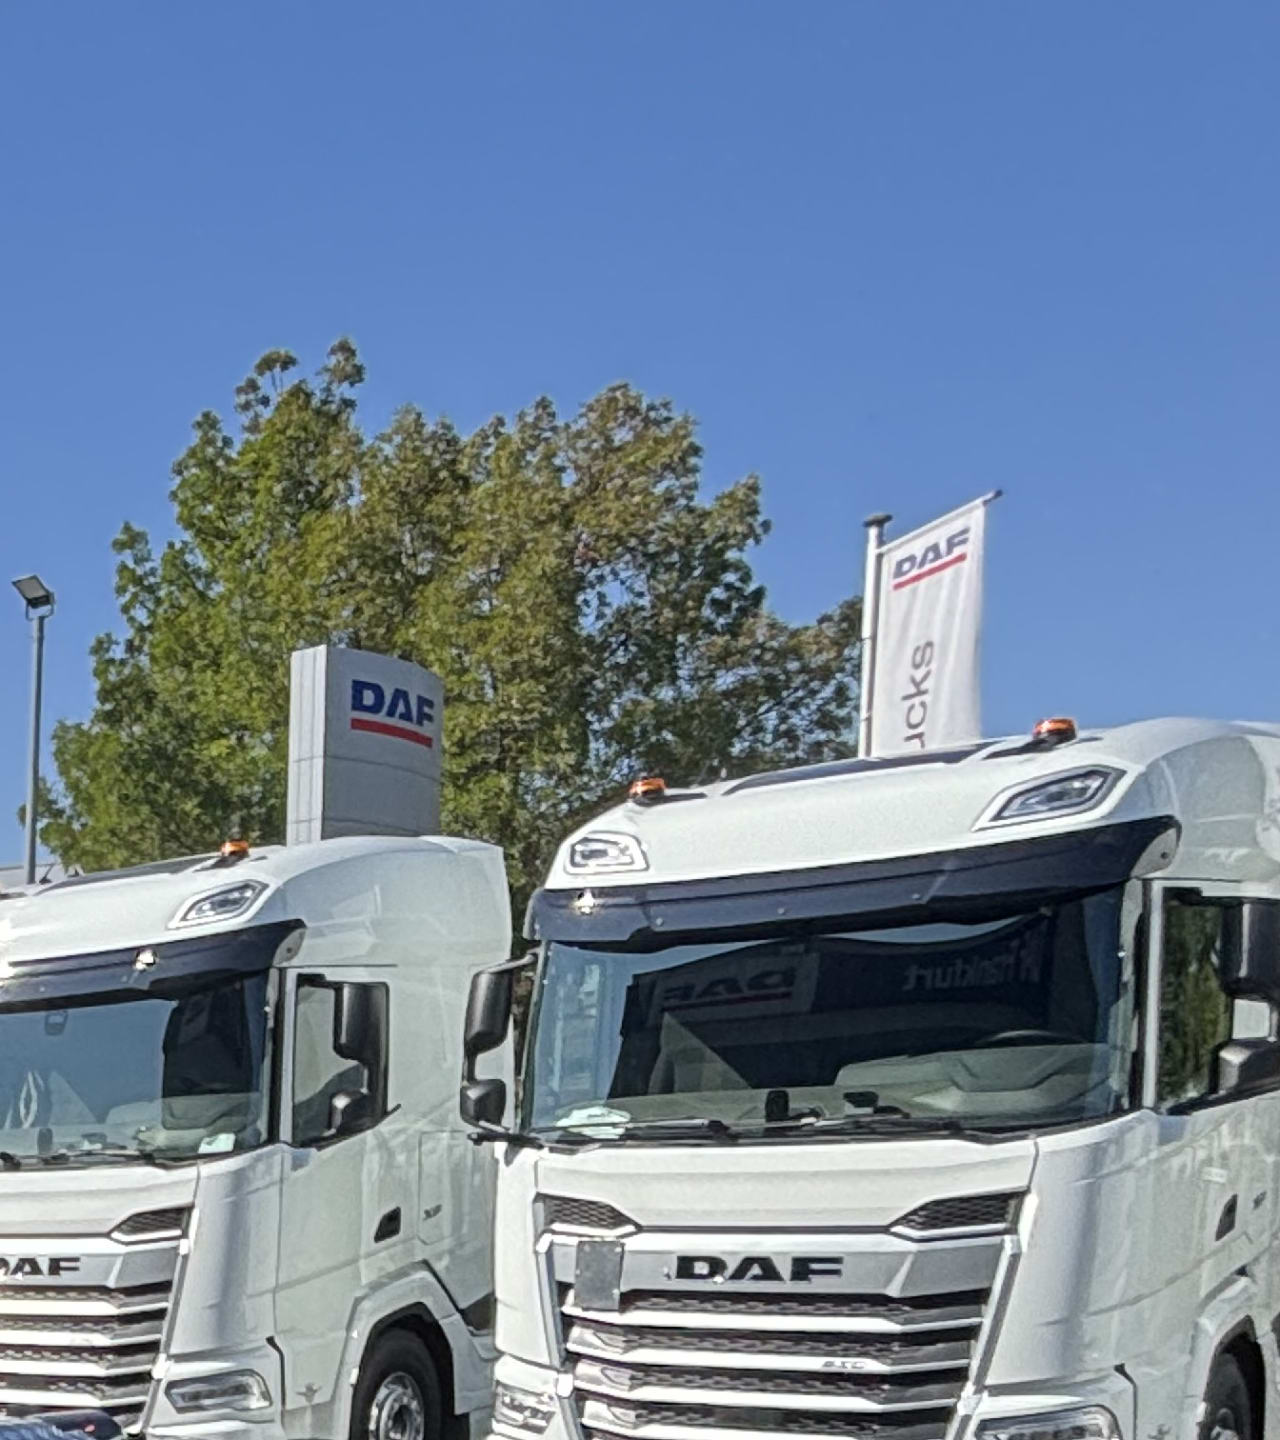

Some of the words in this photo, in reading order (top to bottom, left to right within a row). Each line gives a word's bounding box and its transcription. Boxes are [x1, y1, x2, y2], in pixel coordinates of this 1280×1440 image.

[893, 527, 969, 579] DAF
[351, 679, 434, 727] DAF
[675, 1255, 844, 1283] DAF
